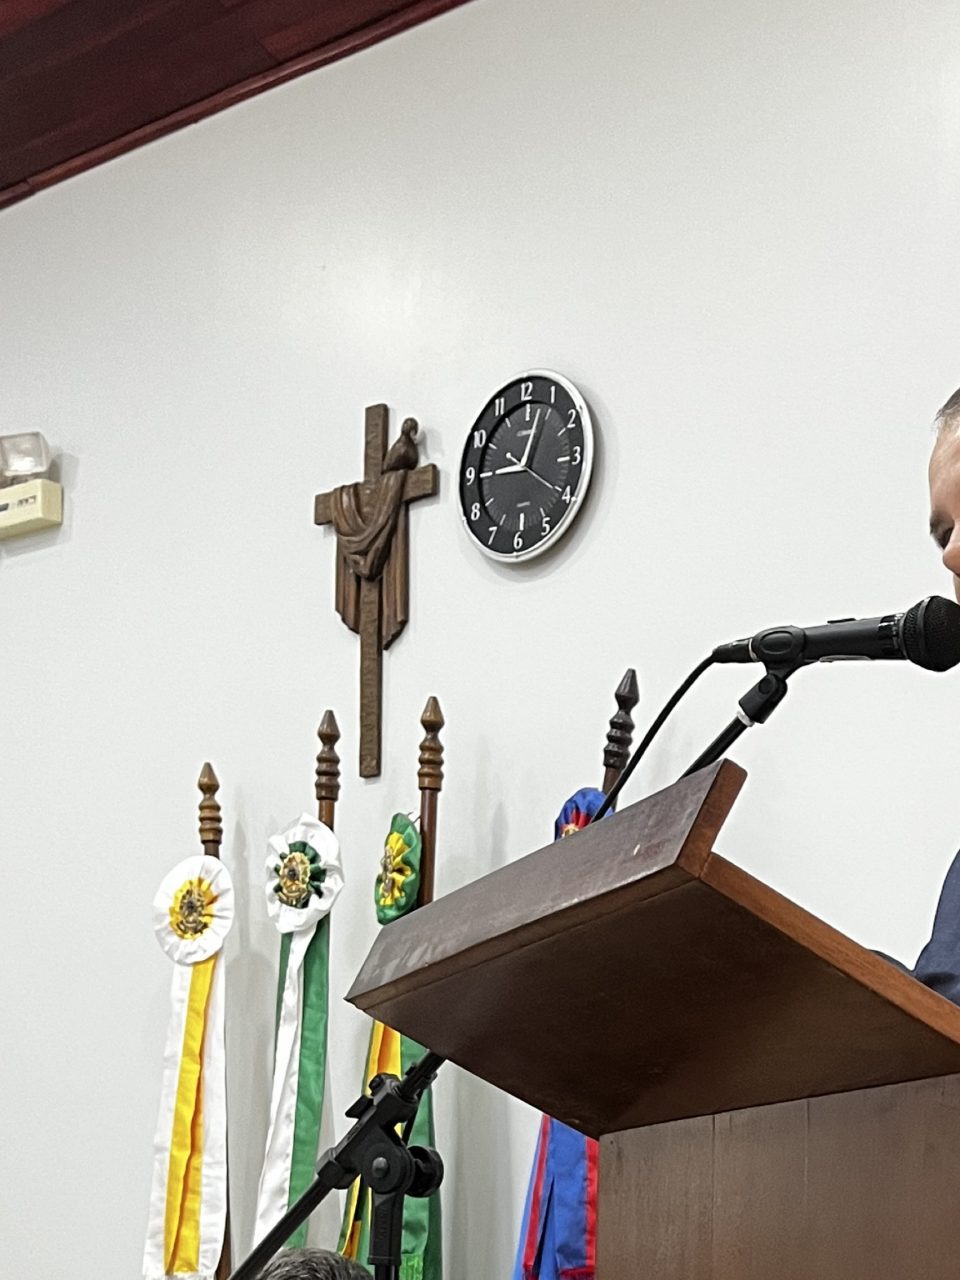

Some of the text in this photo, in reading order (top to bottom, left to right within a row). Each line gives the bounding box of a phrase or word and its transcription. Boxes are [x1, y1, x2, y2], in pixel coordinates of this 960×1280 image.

[521, 382, 533, 400] 12
[550, 386, 555, 403] 1
[495, 398, 505, 416] 11
[567, 409, 576, 428] 2
[473, 429, 486, 448] 10
[571, 446, 581, 465] 3
[466, 467, 475, 486] 9
[562, 486, 571, 503] 4
[471, 502, 480, 521] 8
[541, 517, 551, 535] 5
[488, 527, 497, 545] 7
[513, 533, 523, 549] 6
